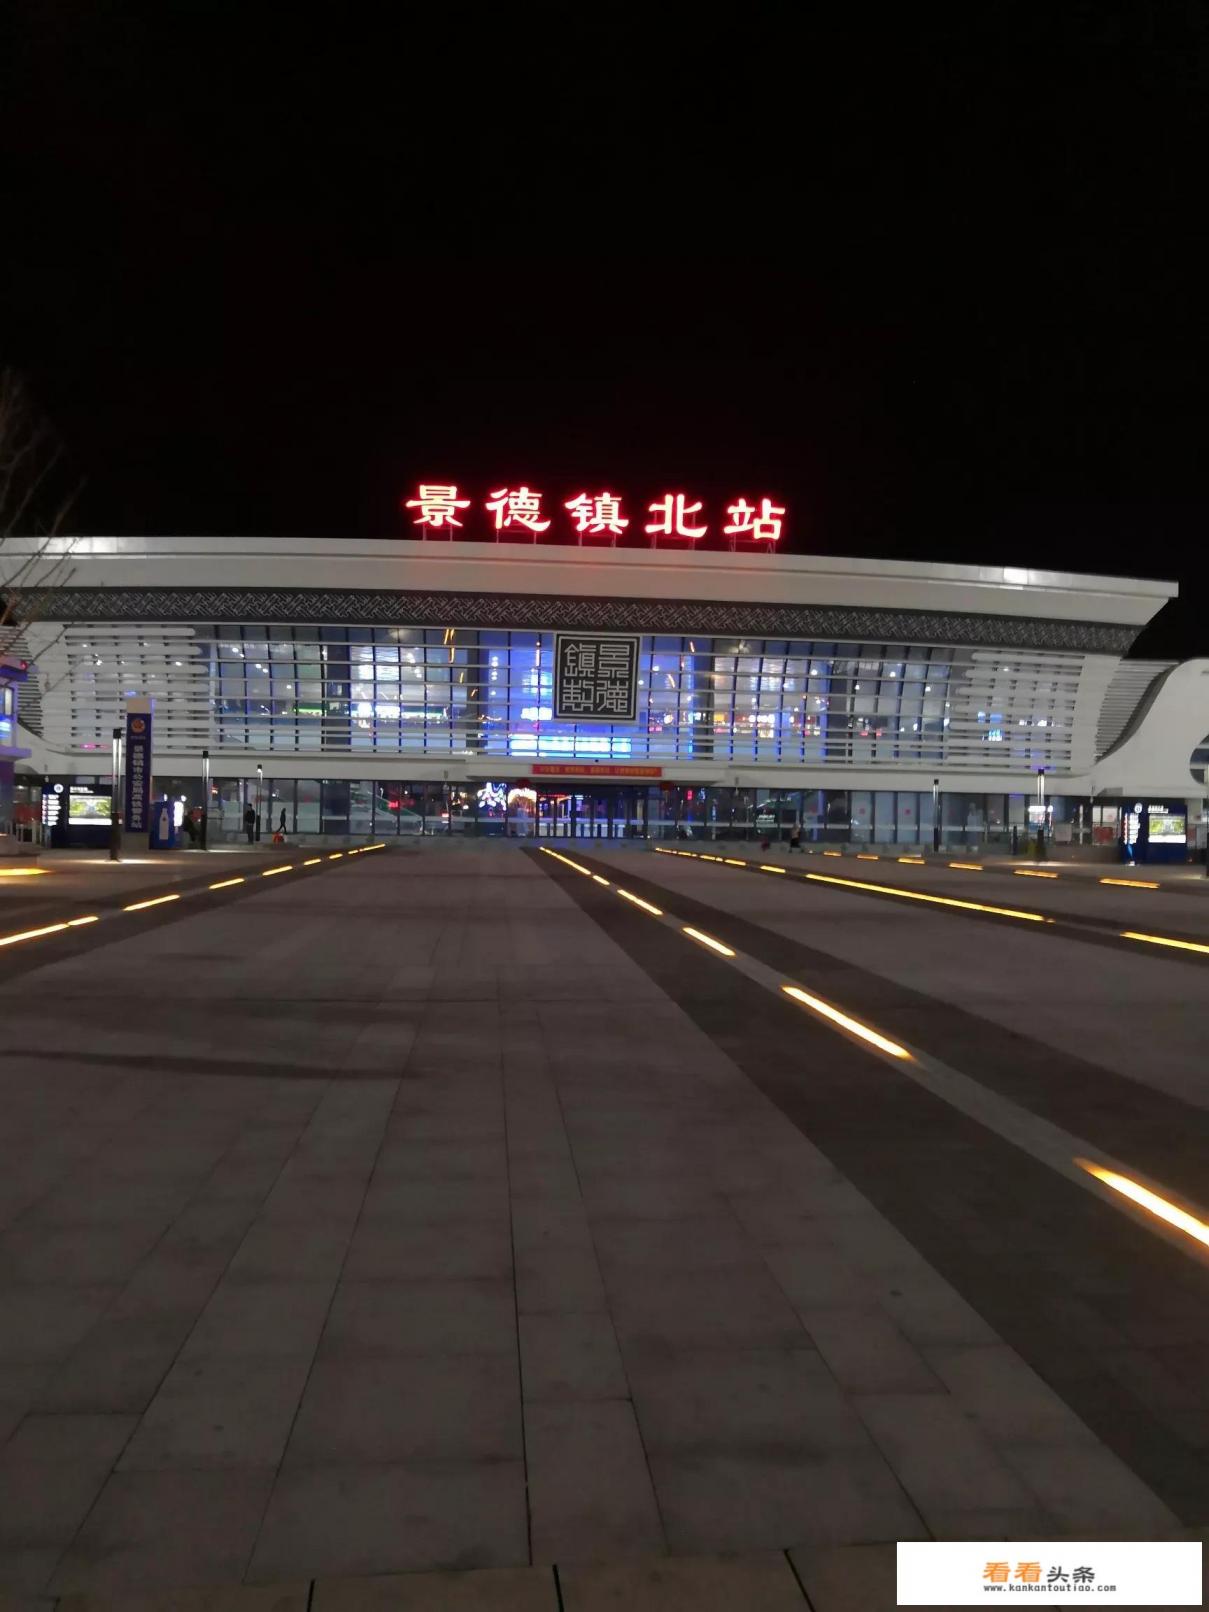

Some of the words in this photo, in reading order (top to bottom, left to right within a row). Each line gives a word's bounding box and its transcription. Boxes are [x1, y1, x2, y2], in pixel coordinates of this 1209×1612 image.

[405, 484, 787, 541] 景德镇北站
